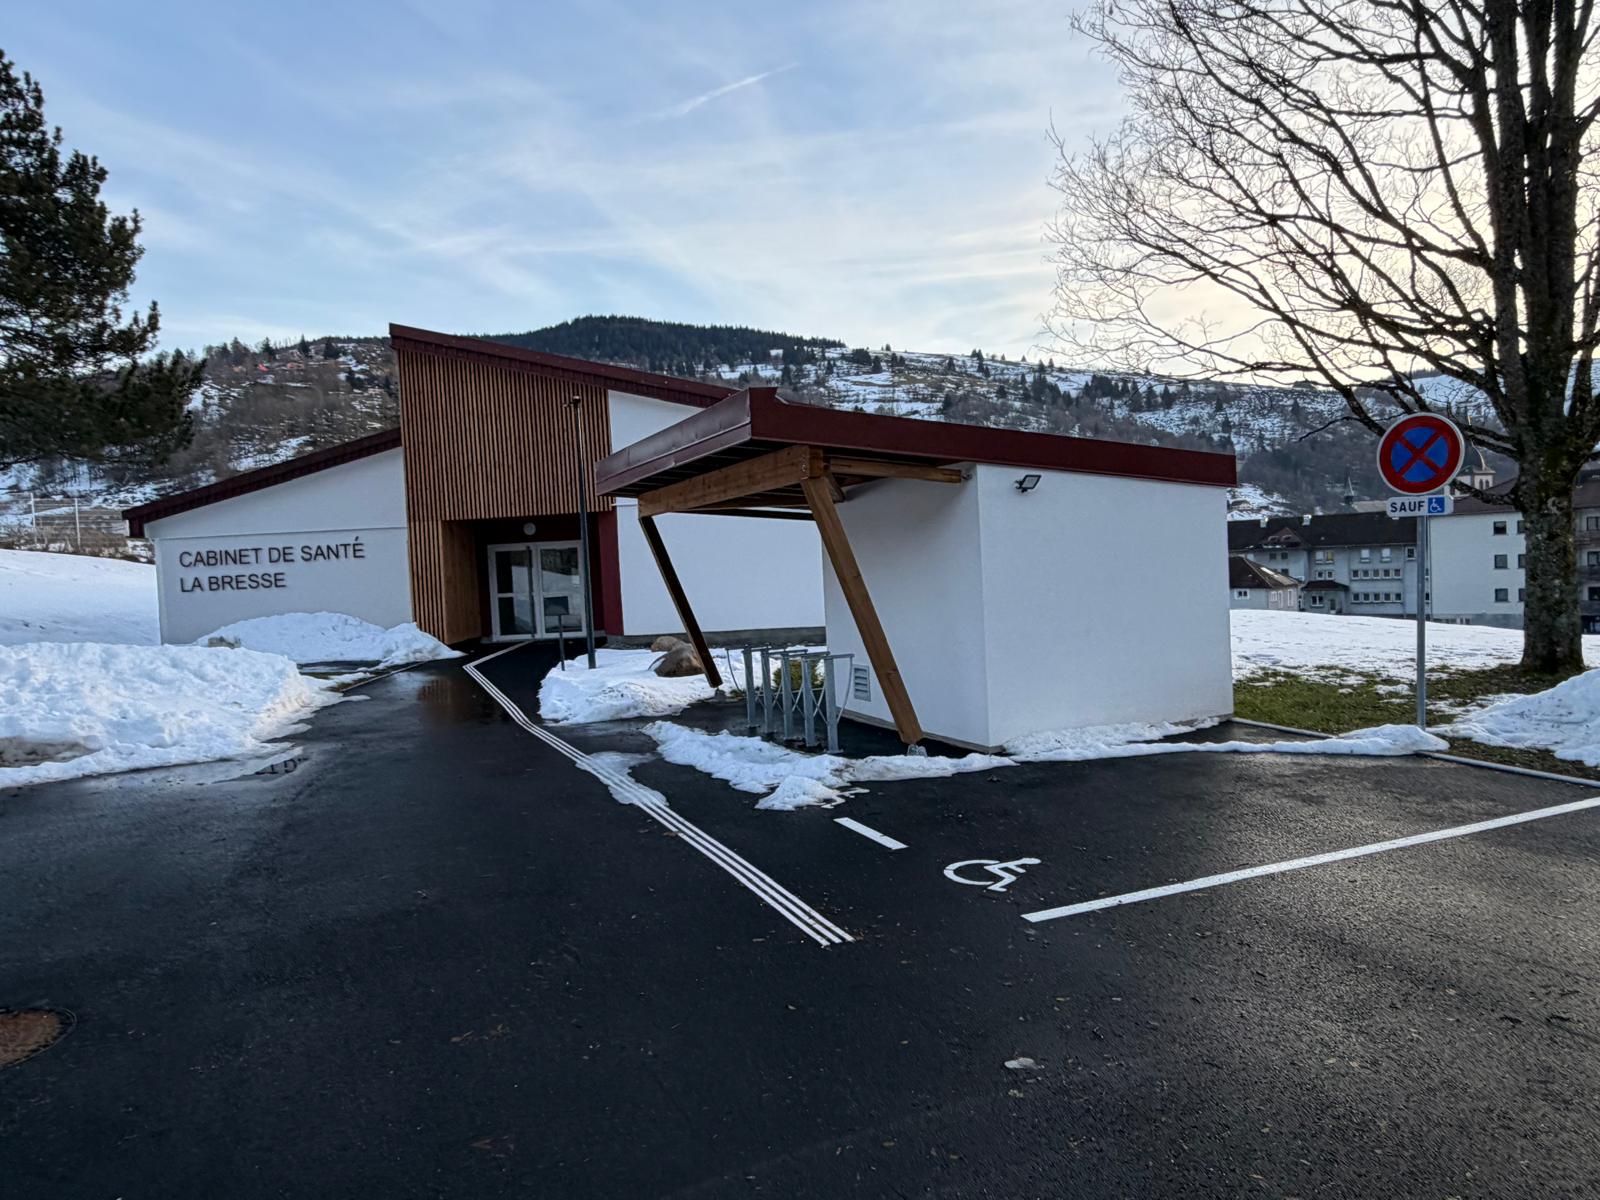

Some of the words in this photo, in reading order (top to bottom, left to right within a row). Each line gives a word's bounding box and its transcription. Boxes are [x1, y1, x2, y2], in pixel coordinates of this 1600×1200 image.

[1390, 500, 1425, 513] SAUF
[179, 548, 262, 568] CABINET
[268, 546, 295, 564] DE
[300, 536, 366, 562] SANTÉ
[180, 577, 204, 593] LA
[208, 572, 287, 592] BRESSE
